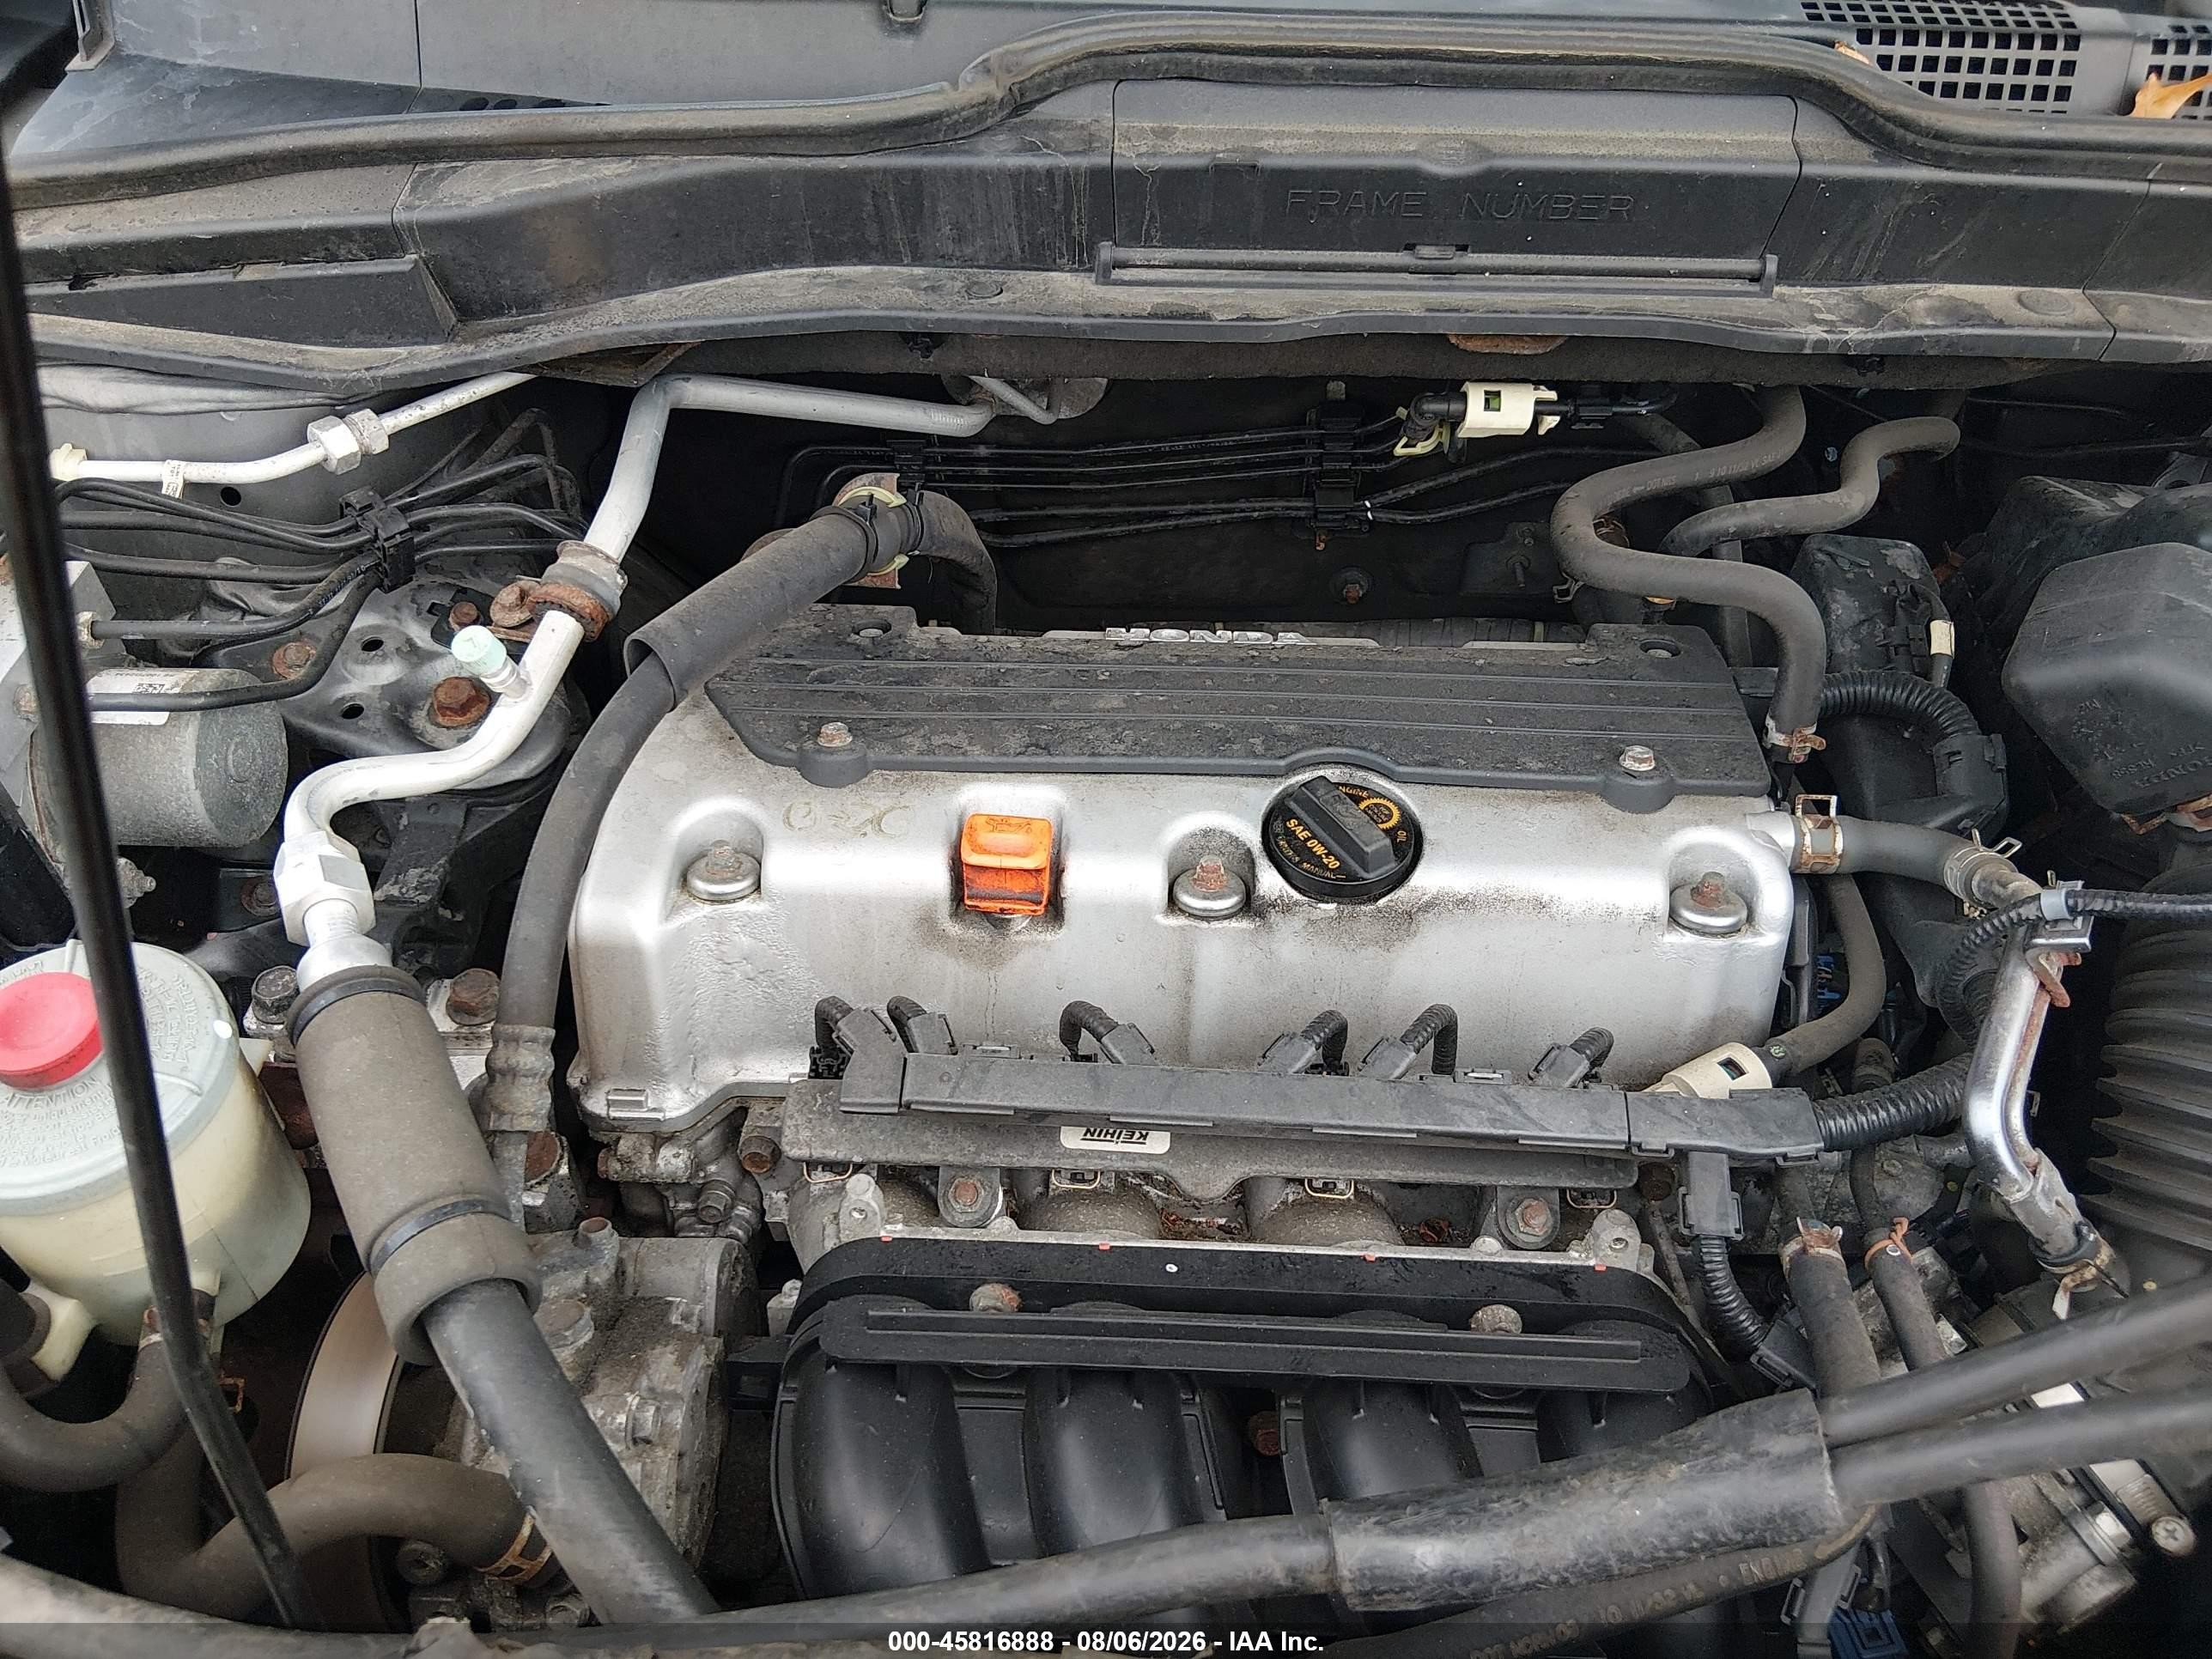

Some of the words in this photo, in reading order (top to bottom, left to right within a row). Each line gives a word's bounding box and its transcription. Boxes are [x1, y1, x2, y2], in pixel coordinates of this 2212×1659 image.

[1287, 190, 1427, 217] FRAME
[1462, 191, 1634, 220] NUMBER
[1105, 628, 1316, 646] HONDA
[1338, 785, 1370, 799] NGINE
[1396, 830, 1408, 843] OIL
[1285, 818, 1310, 841] SAE
[1305, 838, 1341, 870] 0W-20
[0, 1075, 100, 1111] ATTENTION
[1079, 1127, 1150, 1145] KEIHIN
